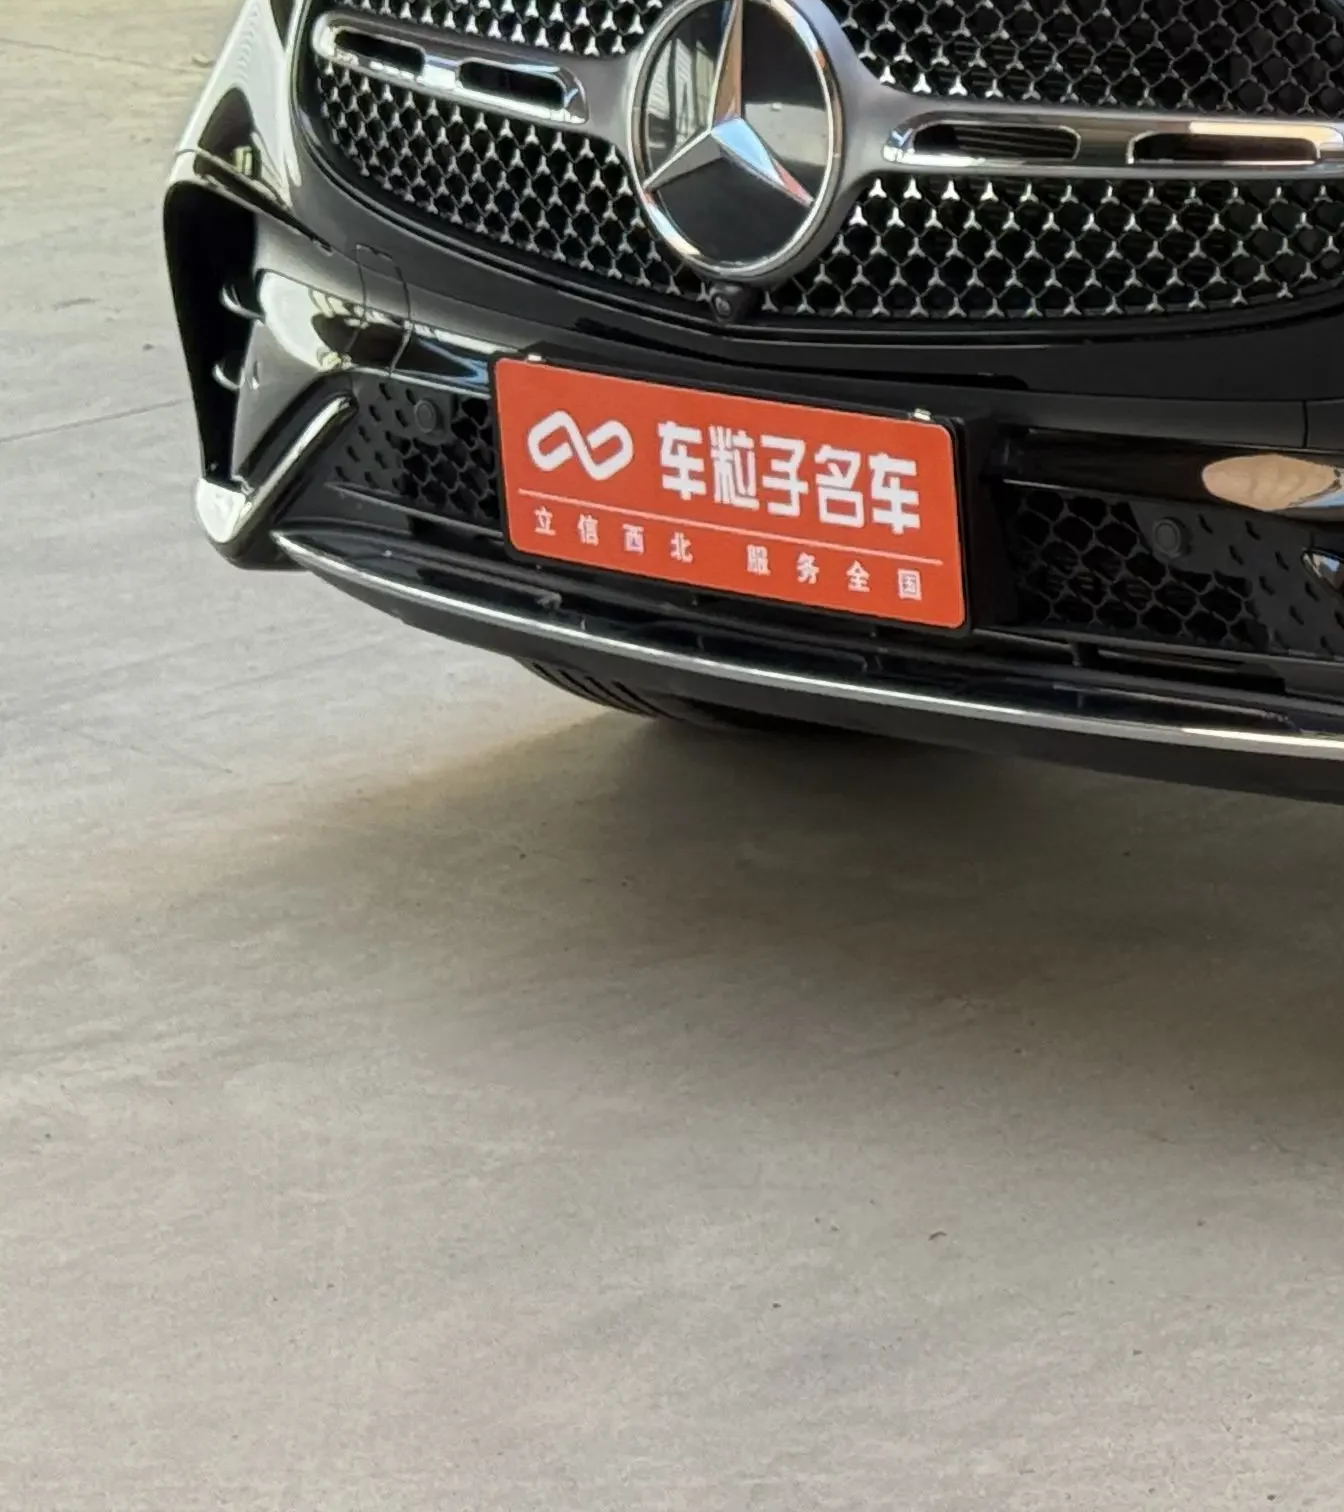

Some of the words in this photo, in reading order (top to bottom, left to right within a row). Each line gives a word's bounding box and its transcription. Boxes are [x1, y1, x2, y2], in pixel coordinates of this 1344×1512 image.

[657, 419, 921, 536] 车粒子名车
[533, 505, 694, 564] 立信西北
[746, 543, 923, 601] 服务全国
